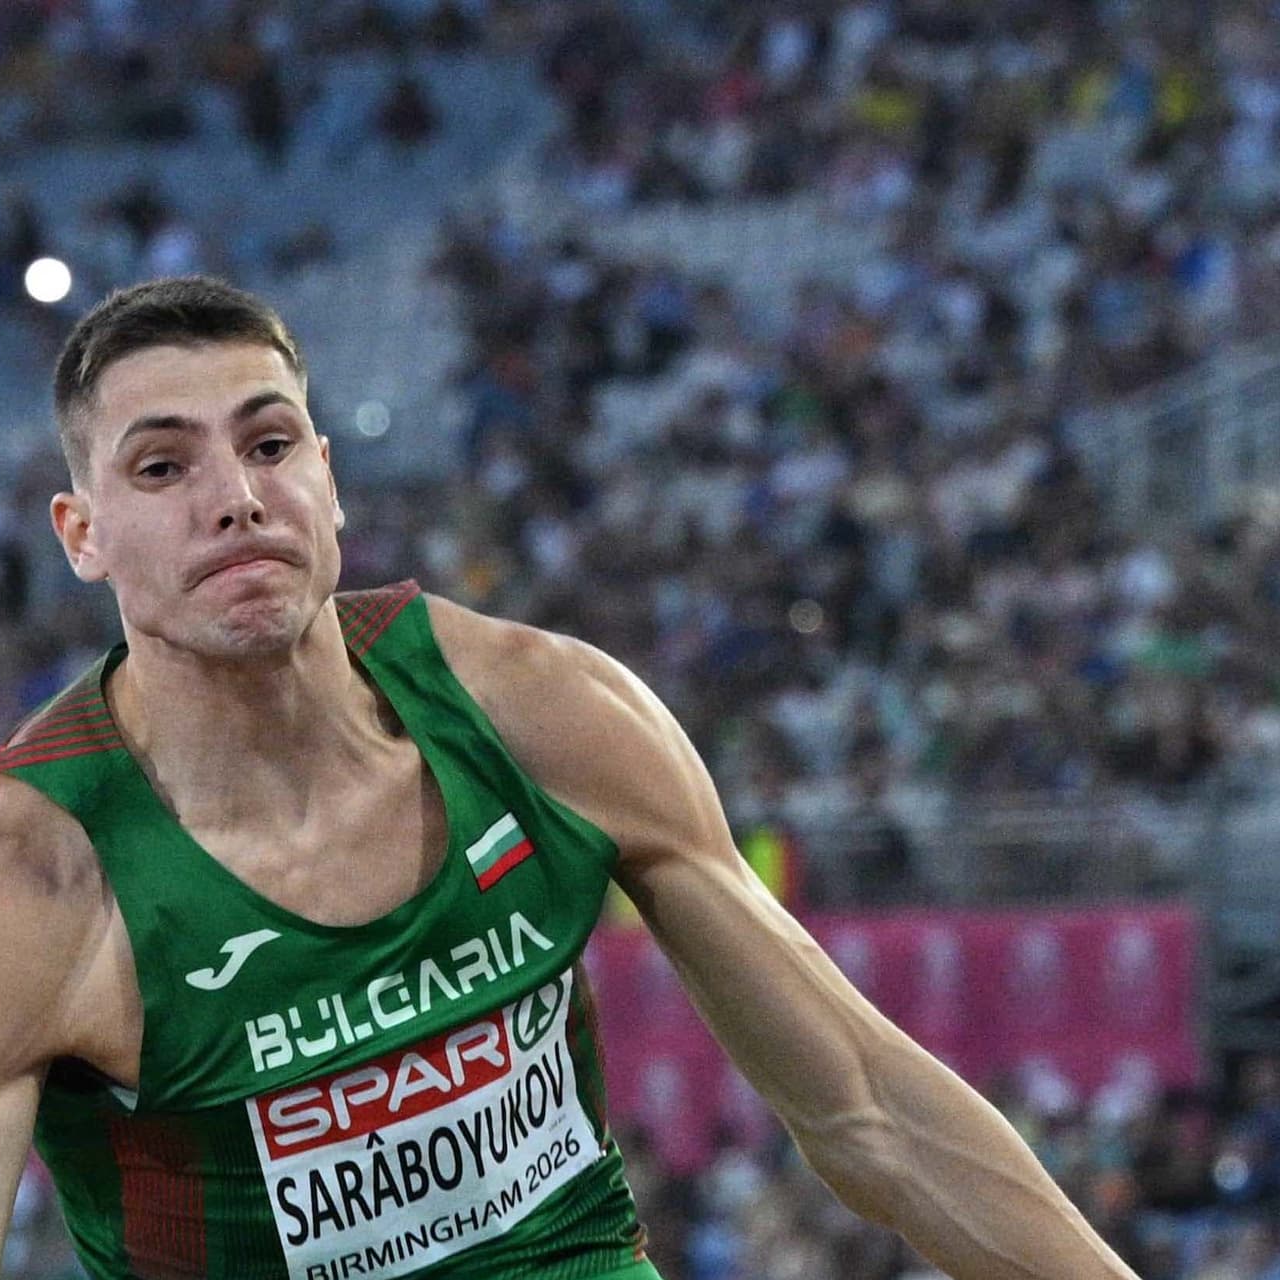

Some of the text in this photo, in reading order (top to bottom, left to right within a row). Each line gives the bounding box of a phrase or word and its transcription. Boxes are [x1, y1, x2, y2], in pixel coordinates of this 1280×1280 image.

[245, 911, 554, 1072] BULGARIA
[267, 1022, 506, 1146] SPAR
[276, 1040, 565, 1246] SARÂBOYUKOV
[524, 1129, 581, 1195] 2026
